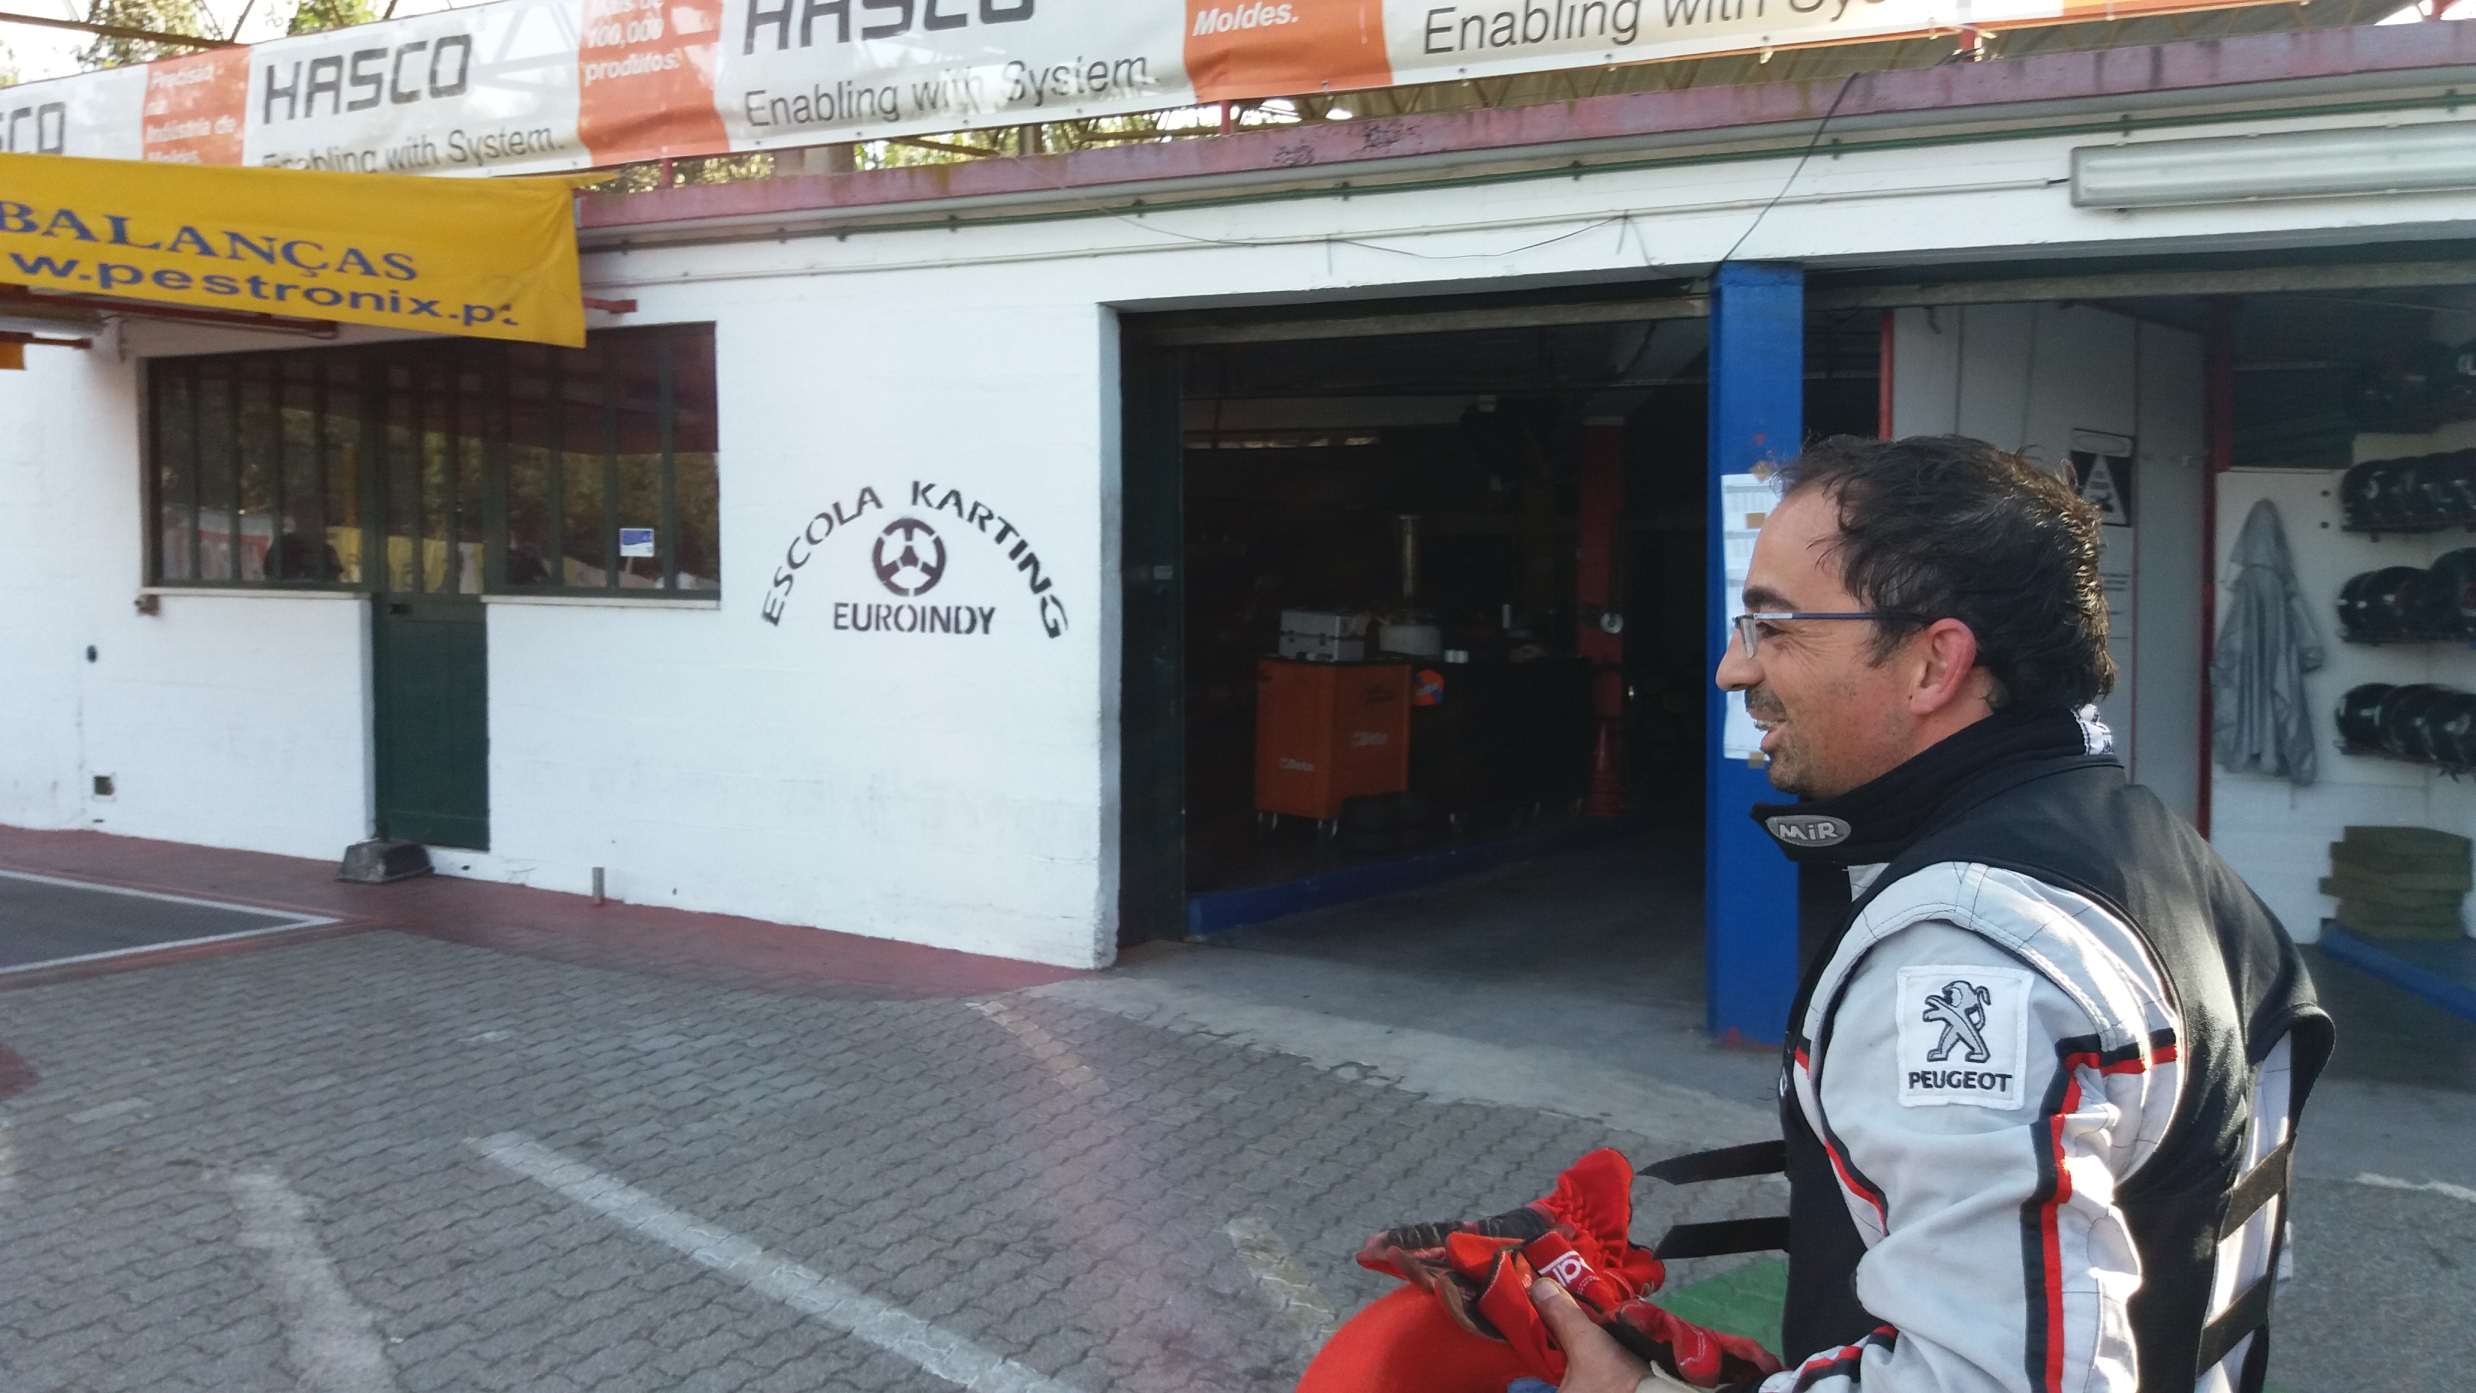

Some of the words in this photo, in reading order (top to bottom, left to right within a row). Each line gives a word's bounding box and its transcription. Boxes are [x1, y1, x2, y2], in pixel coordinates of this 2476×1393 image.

[1192, 1, 1299, 37] Moldes.
[1424, 0, 1641, 55] Enabling
[263, 34, 472, 124] HASCO
[745, 80, 900, 126] Enabling
[448, 126, 565, 167] System.
[0, 200, 417, 281] BALANÇAS
[761, 485, 884, 627] ESCOLA
[911, 480, 1069, 639] KARTING
[833, 602, 997, 635] EUROINDY
[1908, 1070, 2013, 1092] PEUGEOT
